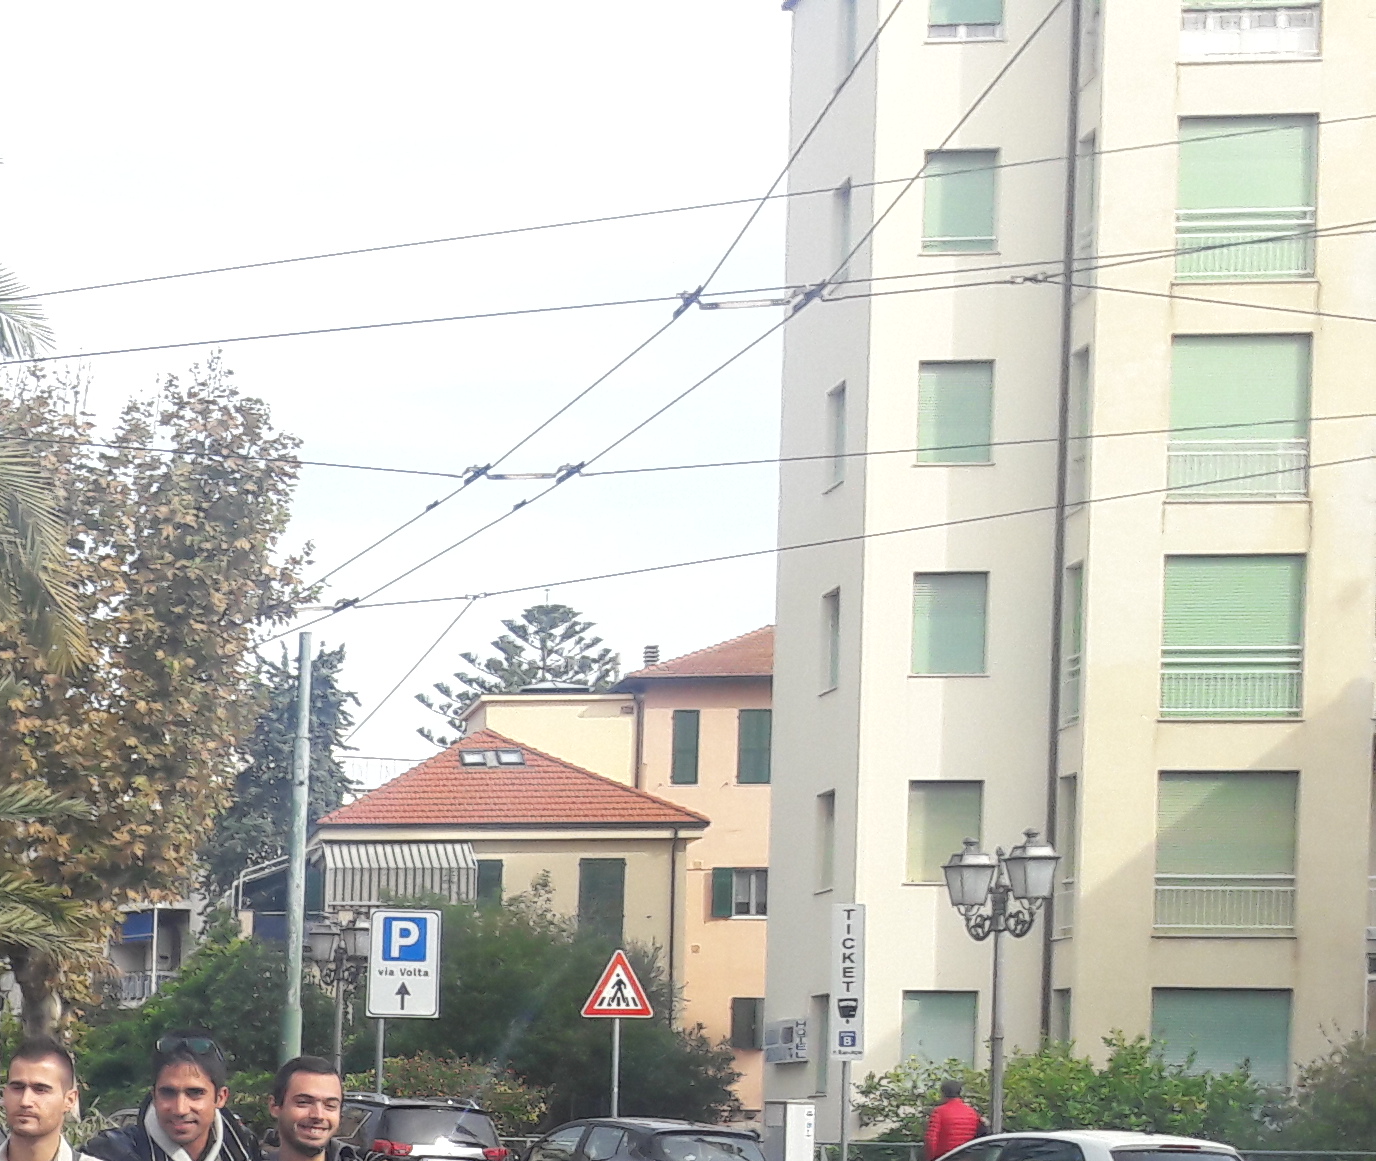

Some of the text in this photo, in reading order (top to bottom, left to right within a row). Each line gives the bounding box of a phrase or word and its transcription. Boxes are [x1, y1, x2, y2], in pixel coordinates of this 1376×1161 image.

[390, 920, 420, 957] P
[841, 908, 857, 993] TICKET
[378, 967, 430, 977] via Volta
[795, 1020, 807, 1059] HOTEL
